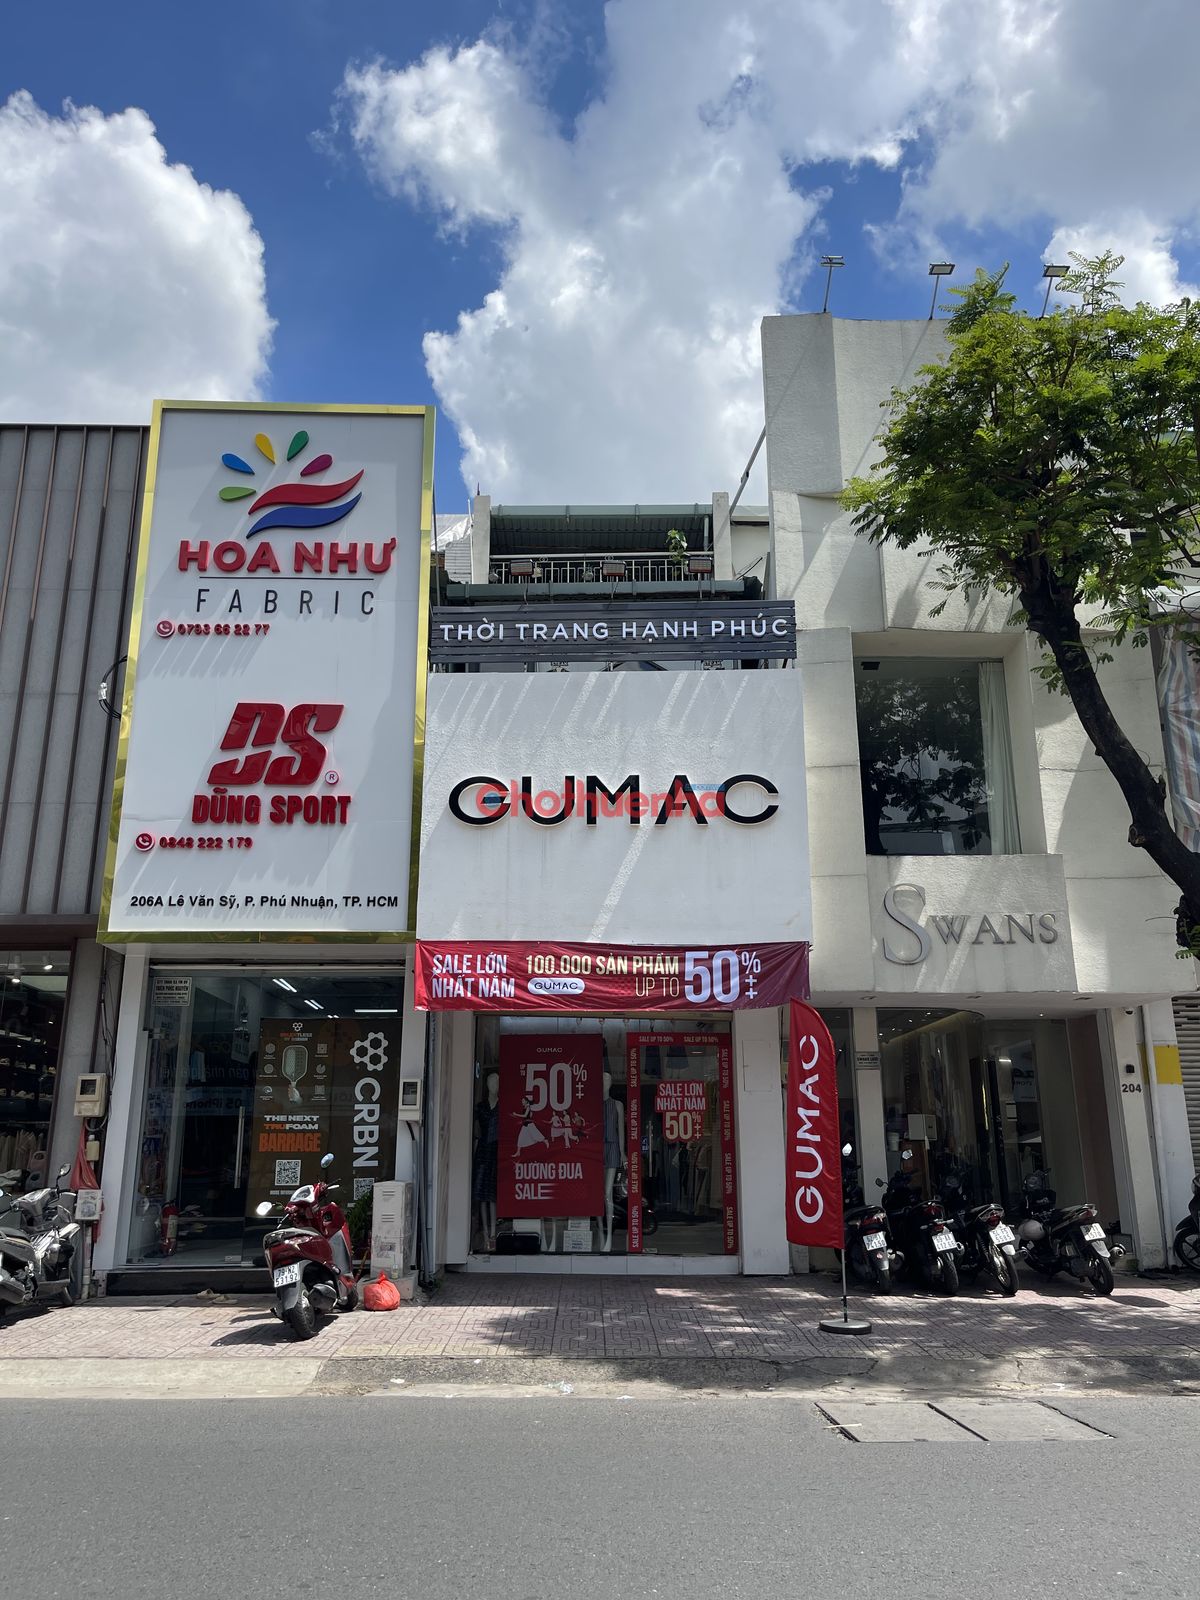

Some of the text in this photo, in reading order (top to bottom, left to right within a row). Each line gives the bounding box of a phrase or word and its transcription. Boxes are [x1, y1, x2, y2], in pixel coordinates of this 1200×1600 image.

[177, 537, 398, 574] HOA NHƯ
[196, 588, 375, 615] FABRIC
[254, 623, 270, 636] 77
[439, 612, 788, 643] THỜI TRANG HẠNH PHÚC
[206, 702, 345, 786] DS
[192, 786, 352, 825] DŨNG SPORT
[448, 773, 780, 826] GUMAC
[130, 895, 164, 907] 206A
[168, 895, 185, 907] Lê
[189, 895, 215, 907] Văn
[244, 896, 255, 907] P.
[260, 894, 287, 907] Phú
[291, 896, 338, 909] Nhuận,
[342, 896, 362, 907] TP.
[367, 896, 399, 907] HCM
[432, 951, 508, 974] SALE LỚN
[526, 954, 592, 975] 100.000
[595, 952, 628, 975] SẢN
[432, 974, 515, 998] NHẤT NĂM
[534, 981, 579, 990] GUMAC
[635, 977, 680, 997] UP TO
[684, 950, 761, 1004] 50%
[659, 1083, 683, 1096] SALE
[1122, 1084, 1142, 1093] 204
[352, 1077, 381, 1168] CRBN
[795, 1034, 824, 1224] GUMAC
[258, 1132, 321, 1152] BARRAGE
[514, 1182, 555, 1200] SALE
